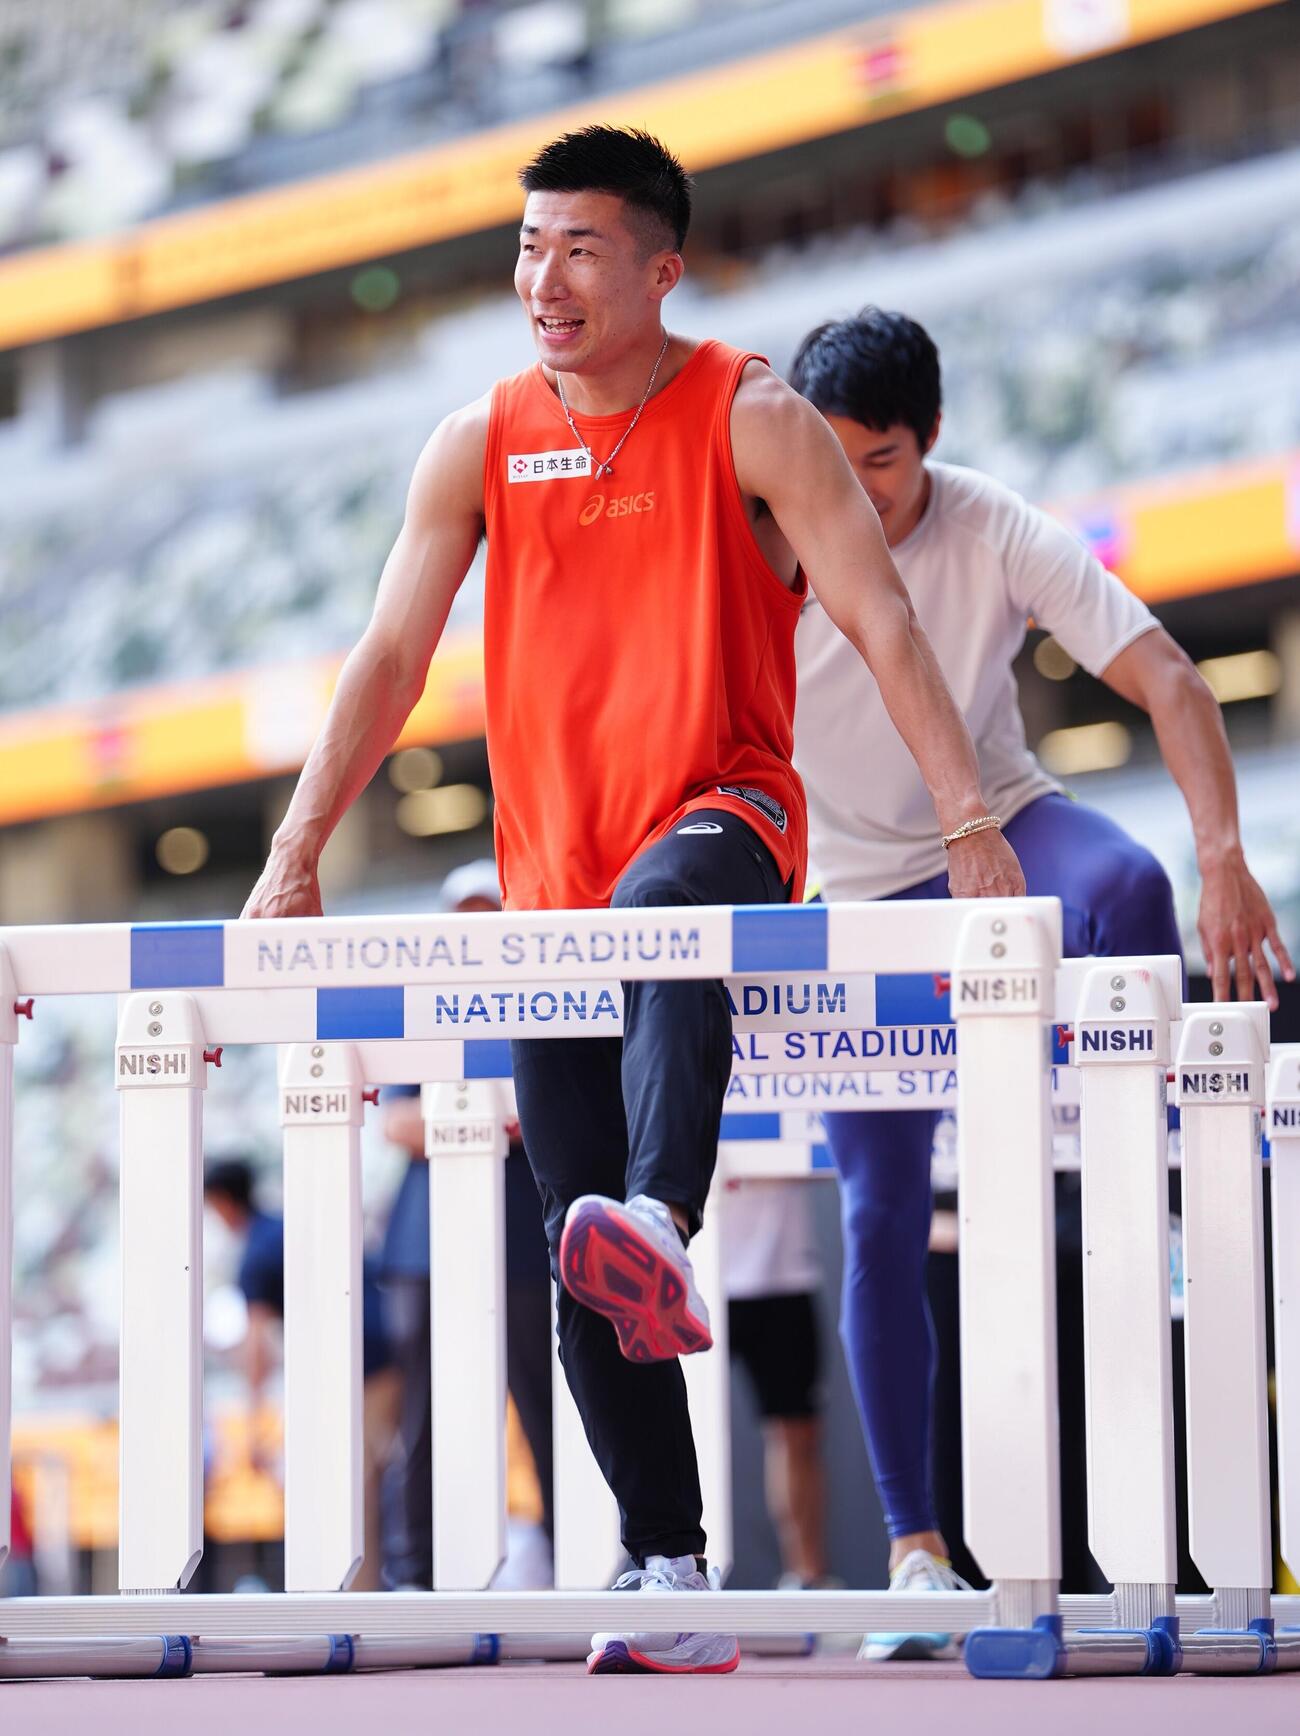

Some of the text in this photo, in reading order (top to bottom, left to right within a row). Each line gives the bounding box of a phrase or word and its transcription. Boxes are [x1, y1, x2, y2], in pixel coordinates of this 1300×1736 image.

[533, 455, 587, 474] 日本生命
[606, 492, 655, 518] asics
[257, 928, 701, 973] NATIONAL STADIUM
[960, 978, 1037, 1001] NISHI
[435, 989, 620, 1024] NATIONA
[784, 1029, 957, 1059] STADIUM
[1081, 1029, 1153, 1051] NISHI
[120, 1053, 187, 1076] NISHI
[727, 1071, 882, 1098] ATIONAL
[1182, 1073, 1249, 1093] NISHI
[285, 1094, 347, 1114] NISHI
[433, 1125, 493, 1145] NISHI
